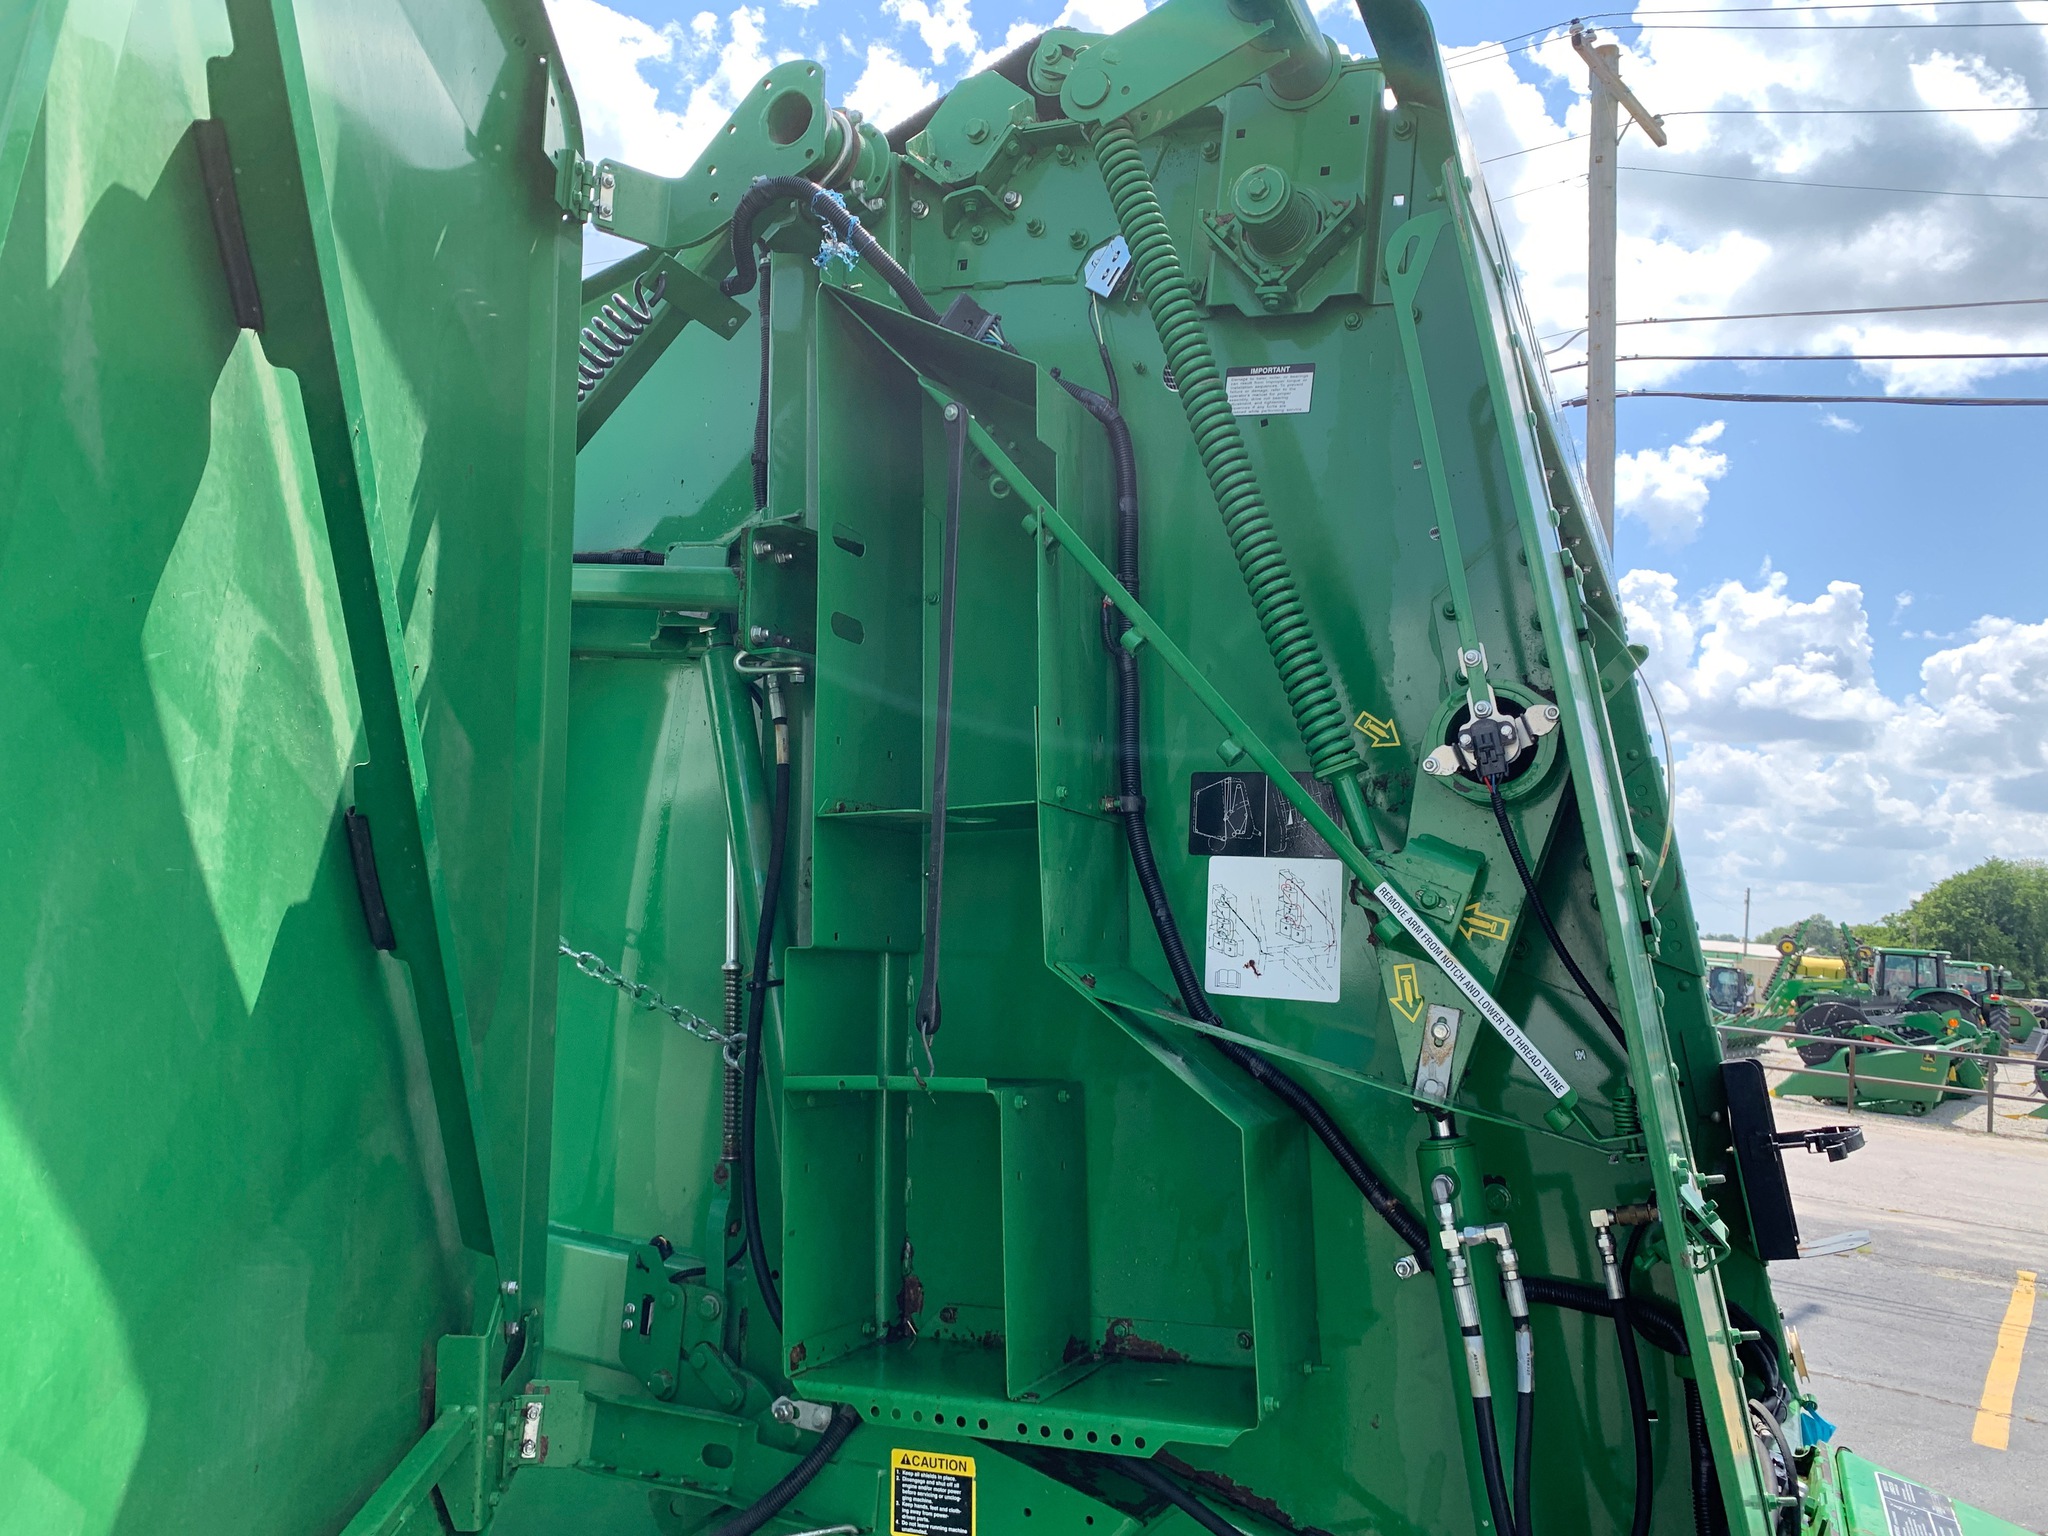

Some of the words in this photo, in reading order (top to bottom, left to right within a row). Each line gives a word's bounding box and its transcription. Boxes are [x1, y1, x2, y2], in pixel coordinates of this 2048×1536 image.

[1250, 366, 1291, 374] IMPORTANT
[1379, 887, 1408, 918] REMOVE
[1405, 917, 1423, 935] ARM
[1421, 933, 1443, 957] FROM
[1440, 955, 1466, 982] NOTCH
[1463, 981, 1480, 998] AND
[1478, 996, 1505, 1026] LOWER
[1503, 1023, 1515, 1037] TO
[1512, 1035, 1542, 1067] THREAD
[1540, 1065, 1565, 1093] TWINE
[912, 1455, 967, 1472] CAUTION
[902, 1476, 925, 1485] Disengage
[917, 1491, 938, 1499] servicing
